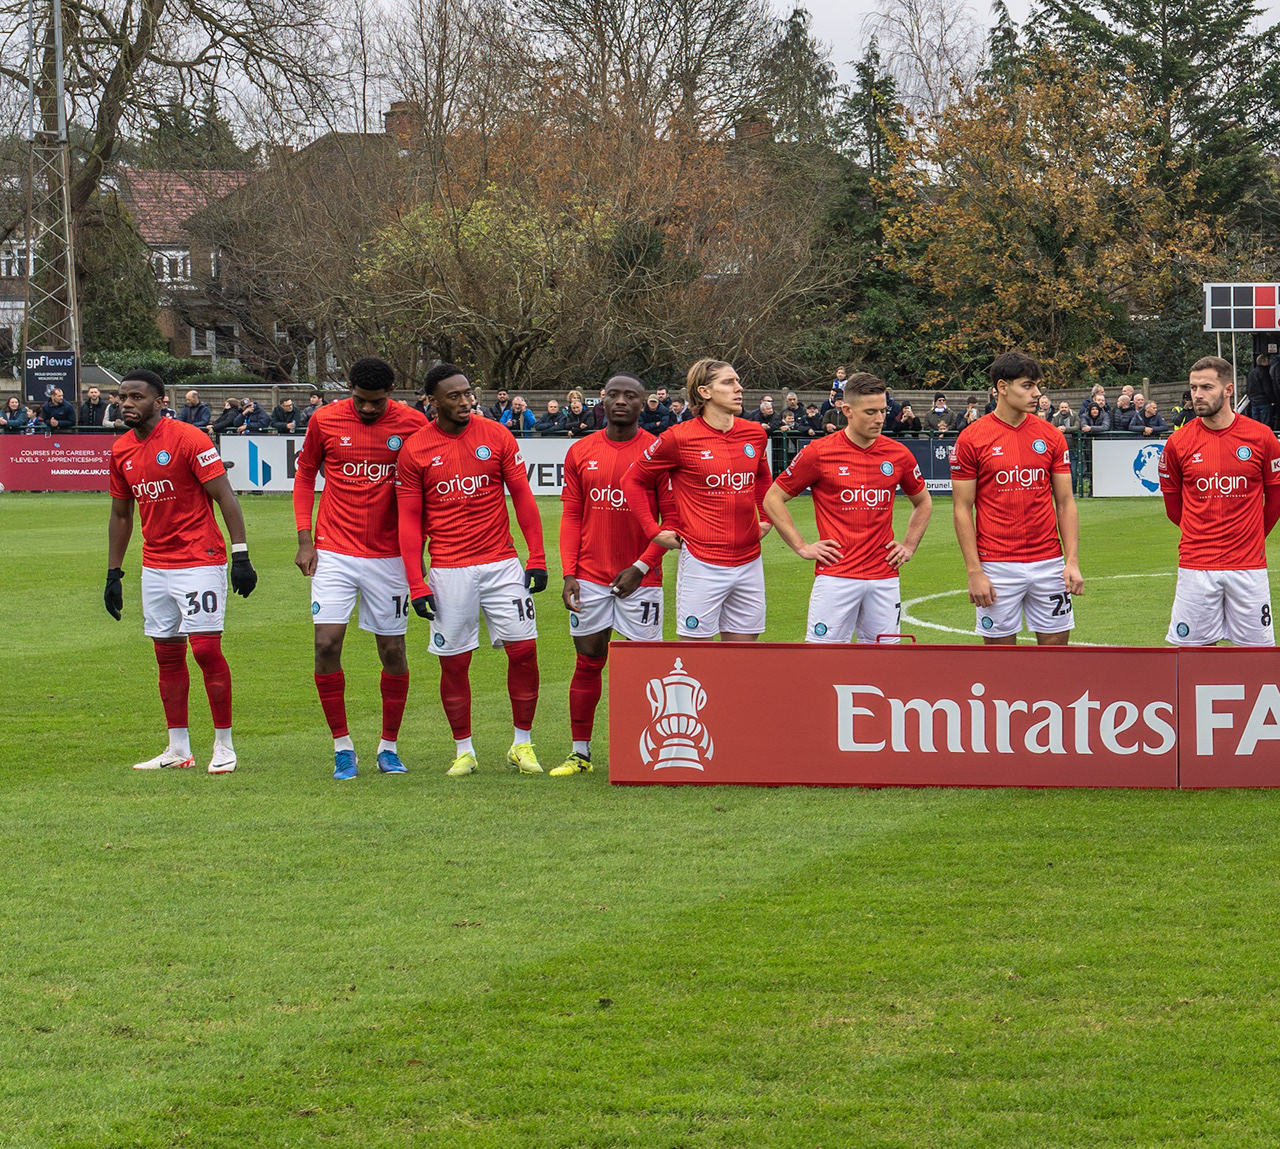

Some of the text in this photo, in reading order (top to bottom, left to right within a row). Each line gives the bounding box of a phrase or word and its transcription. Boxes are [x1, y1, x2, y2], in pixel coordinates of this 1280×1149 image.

[436, 474, 490, 495] origin
[705, 469, 756, 490] origin
[996, 465, 1045, 487] origin
[1196, 472, 1248, 494] origin
[131, 478, 175, 500] origin
[590, 484, 627, 507] orig
[840, 485, 891, 507] origin
[185, 591, 217, 616] 30
[512, 597, 535, 622] 18
[641, 602, 660, 626] 11
[1261, 604, 1271, 626] 8
[834, 682, 1176, 756] Emirates
